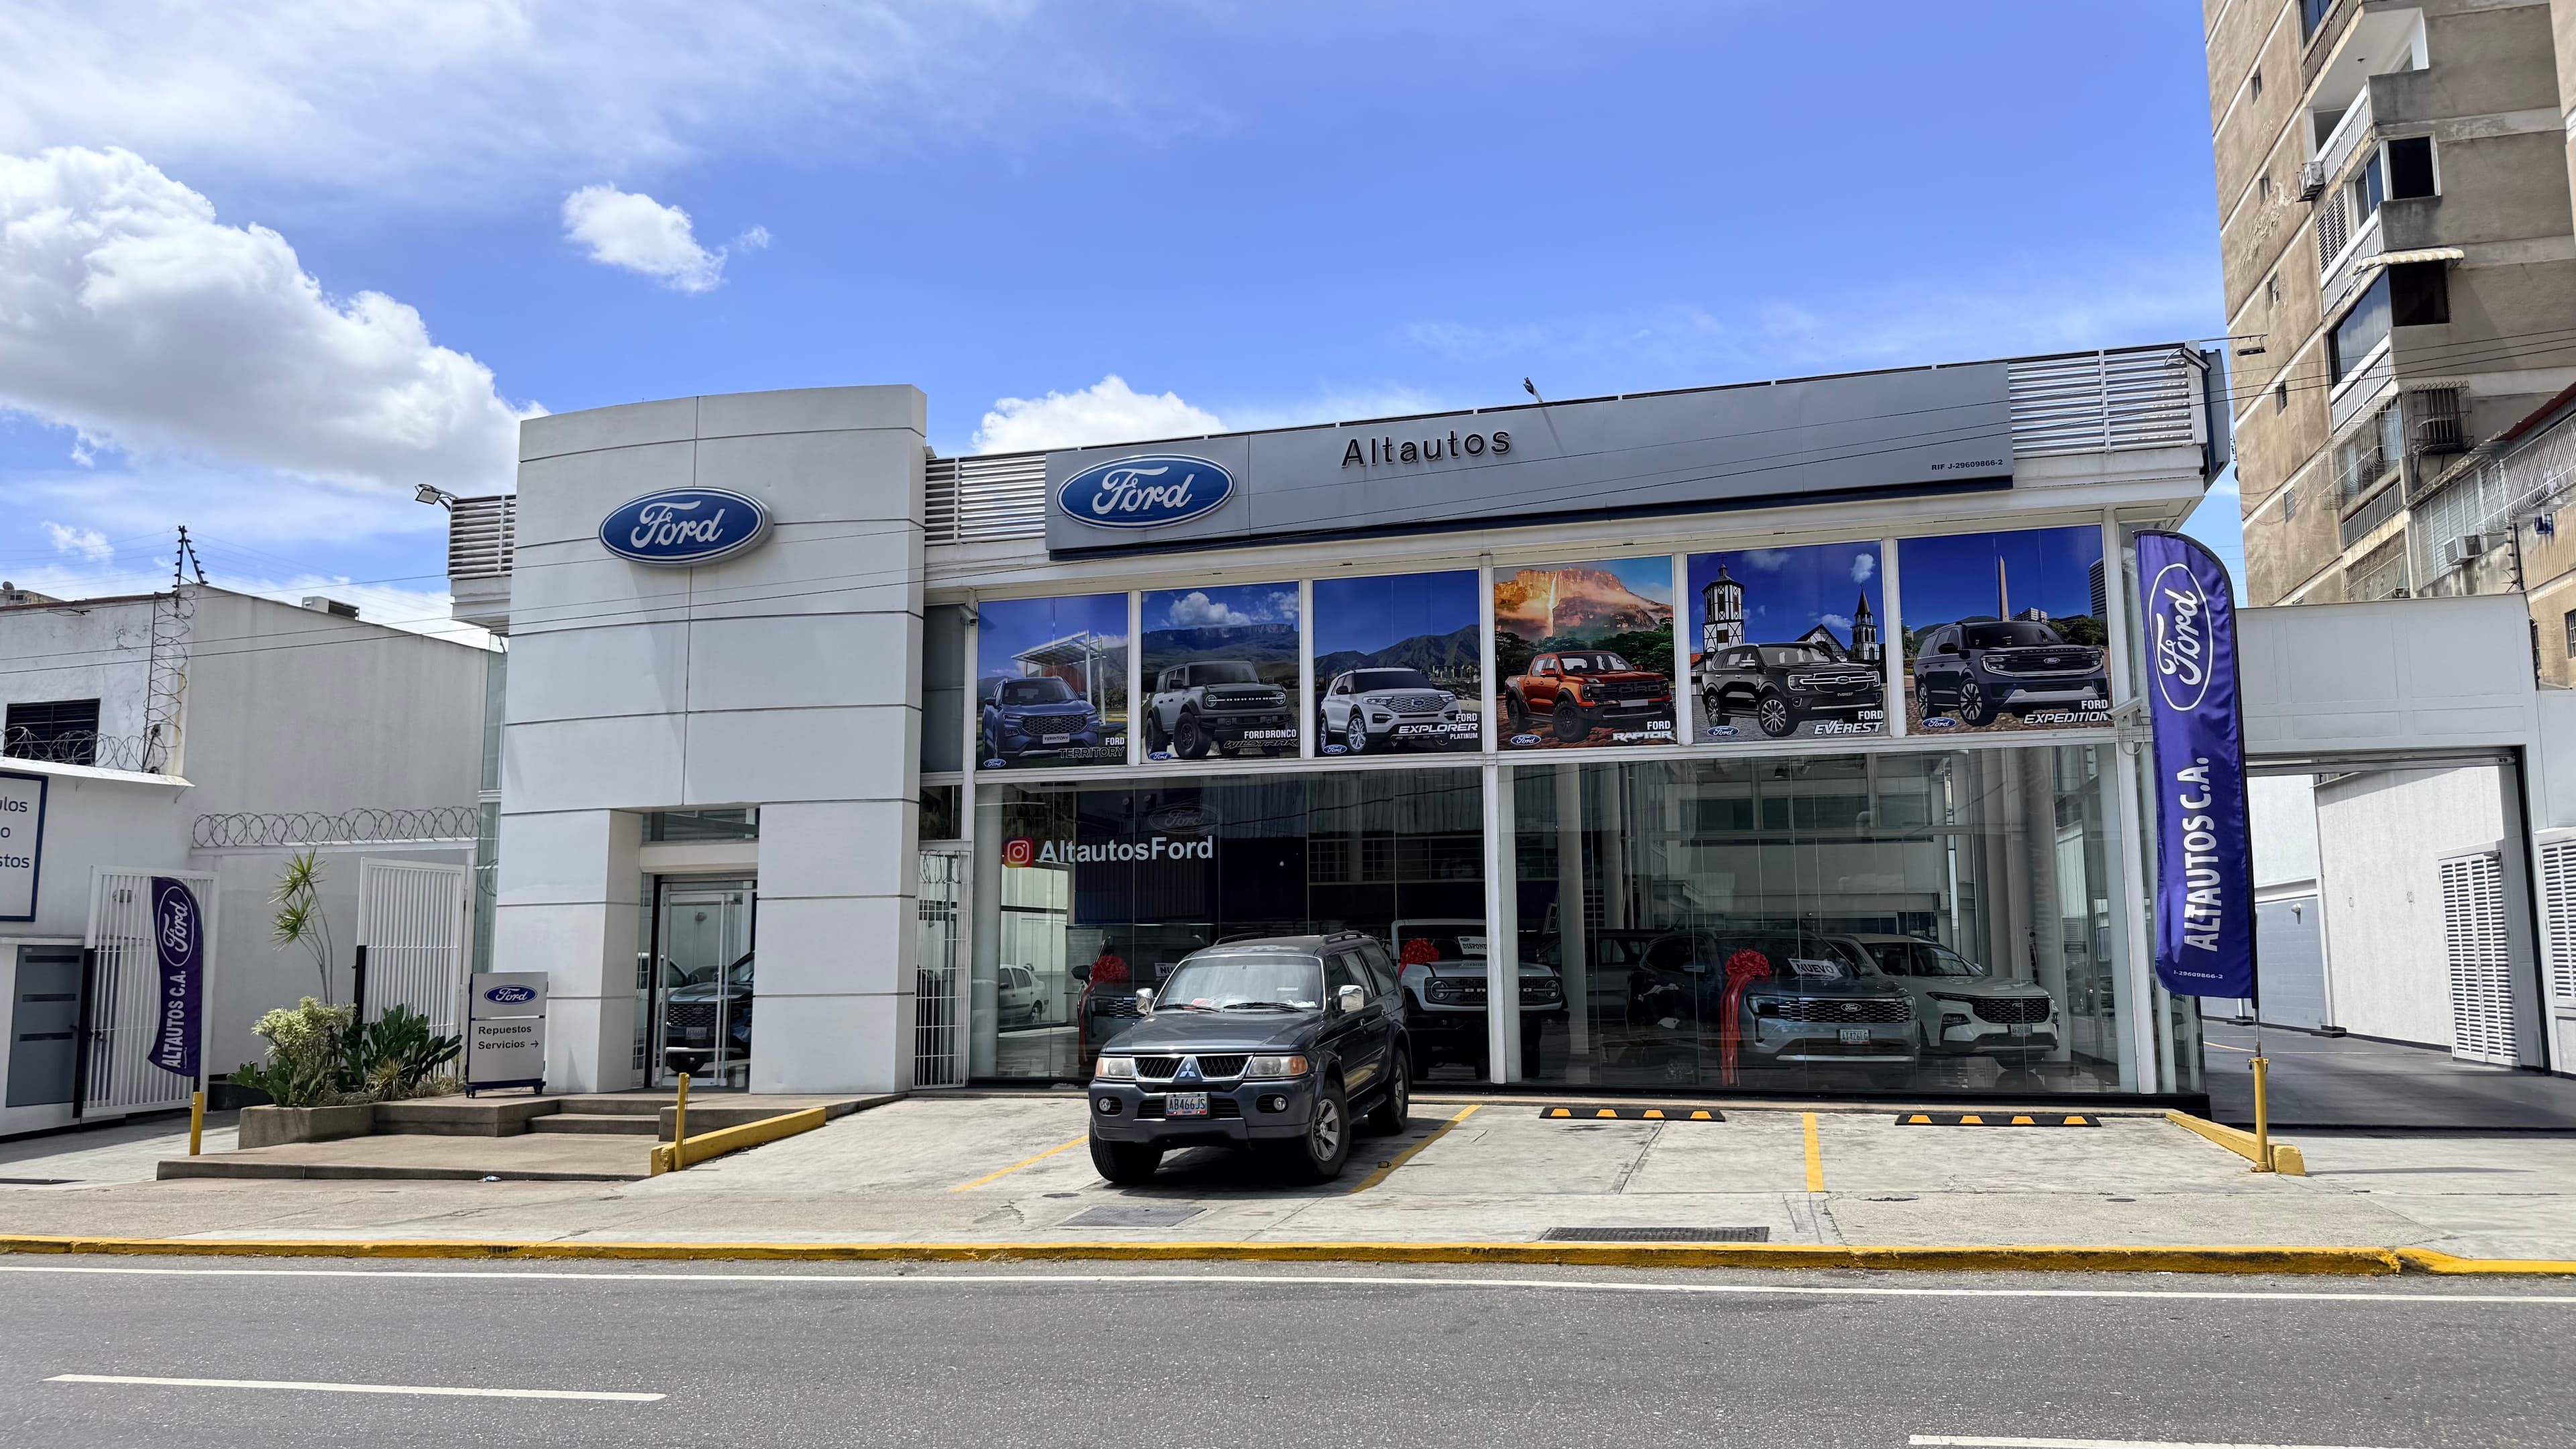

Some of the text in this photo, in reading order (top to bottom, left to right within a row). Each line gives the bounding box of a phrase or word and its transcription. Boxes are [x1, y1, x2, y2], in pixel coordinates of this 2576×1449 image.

[1341, 429, 1511, 469] Altautos
[1947, 459, 2003, 470] J-29609866-2
[1091, 466, 1195, 515] Ford
[630, 500, 725, 549] Ford
[2156, 588, 2199, 686] Ford
[2081, 699, 2108, 710] FORD
[1456, 713, 1477, 722] FORD
[1858, 710, 1884, 720] FORD
[1398, 722, 1479, 735] EXPLORER
[1647, 720, 1671, 731] FORD
[1814, 720, 1884, 735] EVEREST
[1244, 729, 1297, 739] FORD BRONCO
[1450, 732, 1478, 740] PLATINUM
[1612, 730, 1676, 743] RAPTOR
[1105, 737, 1125, 746] FORD
[1224, 739, 1299, 749] WILDTRAK
[1059, 746, 1126, 759] TERRITORY
[1165, 809, 1204, 826] Ford
[1038, 836, 1213, 863] AltautosFord
[2177, 757, 2220, 952] ALTAUTOS C.A.
[163, 900, 189, 953] Ford
[1796, 963, 1835, 974] NUEVO
[495, 987, 529, 1001] Ford
[161, 970, 186, 1068] ALTAUTOS C.A.
[478, 1026, 532, 1036] Repuestos
[478, 1040, 525, 1049] Servicios
[1169, 1098, 1205, 1110] AB466JS
